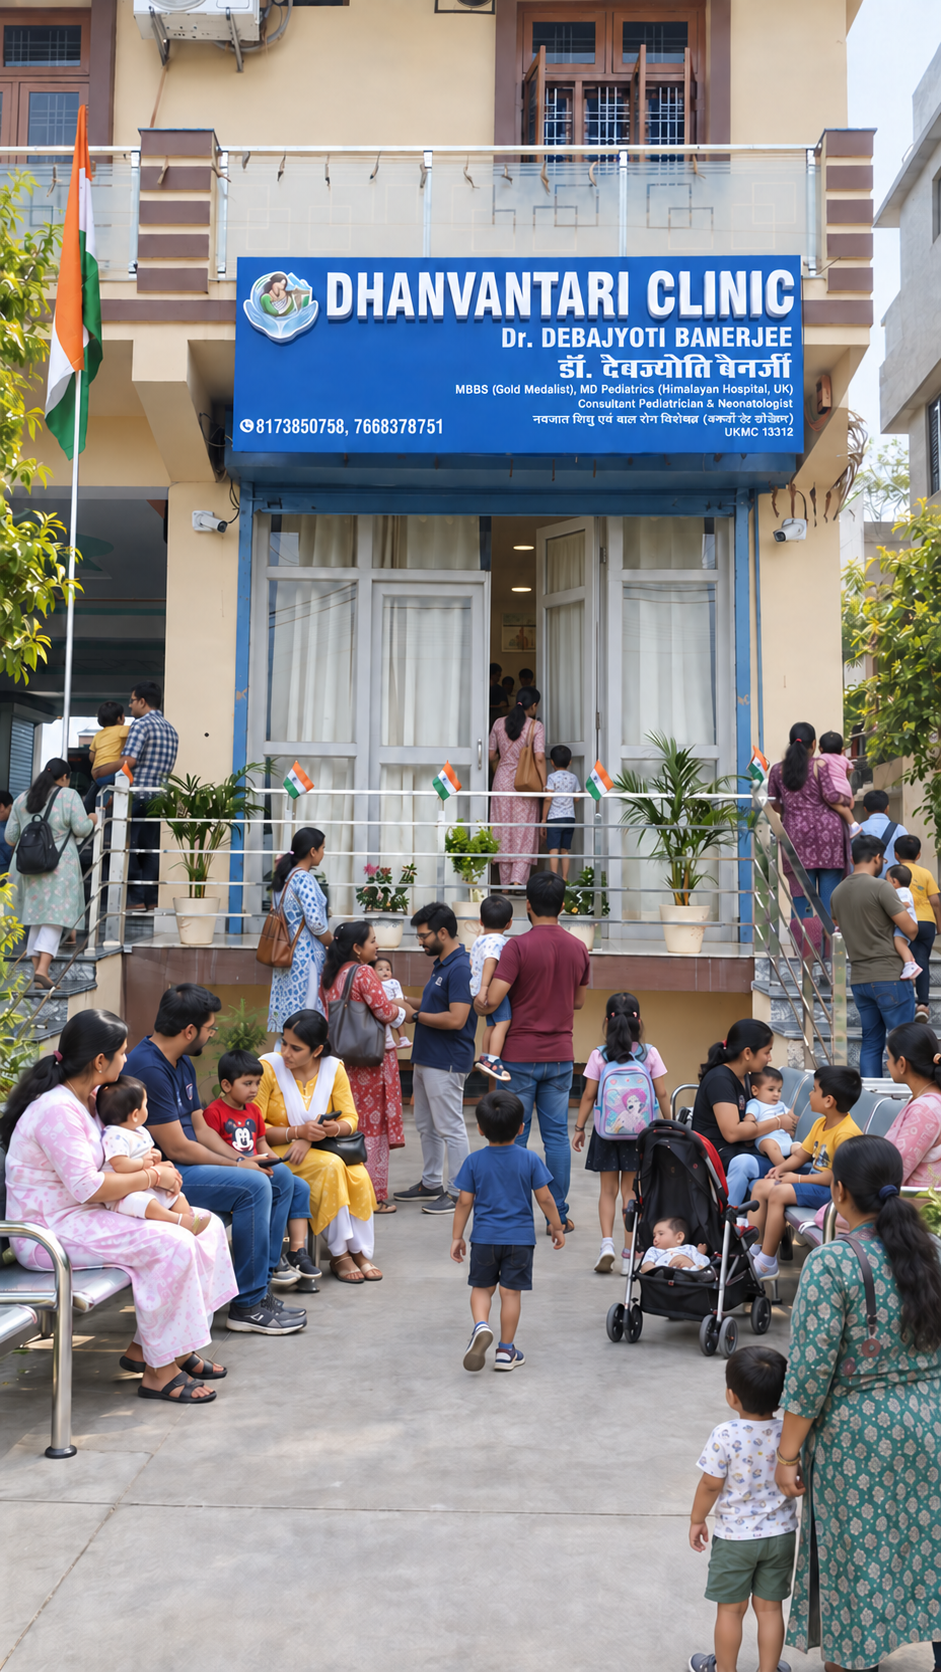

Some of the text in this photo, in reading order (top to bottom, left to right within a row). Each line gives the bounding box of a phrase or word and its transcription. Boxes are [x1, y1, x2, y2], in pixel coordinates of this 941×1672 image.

[326, 268, 796, 318] DHANVANTARI CLINIC
[501, 327, 793, 348] Dr. DEBAJYOTI BANERJEE
[557, 353, 593, 379] डॉ.
[455, 383, 794, 397] MBBS (Gold Medalist), MD Pediatrics (Himalayan Hospital, UK)
[577, 398, 794, 411] Consultant Pediatrician & Neonatologist
[256, 418, 443, 437] 8173850758, 7668378751
[724, 427, 794, 437] UKMC 13312
